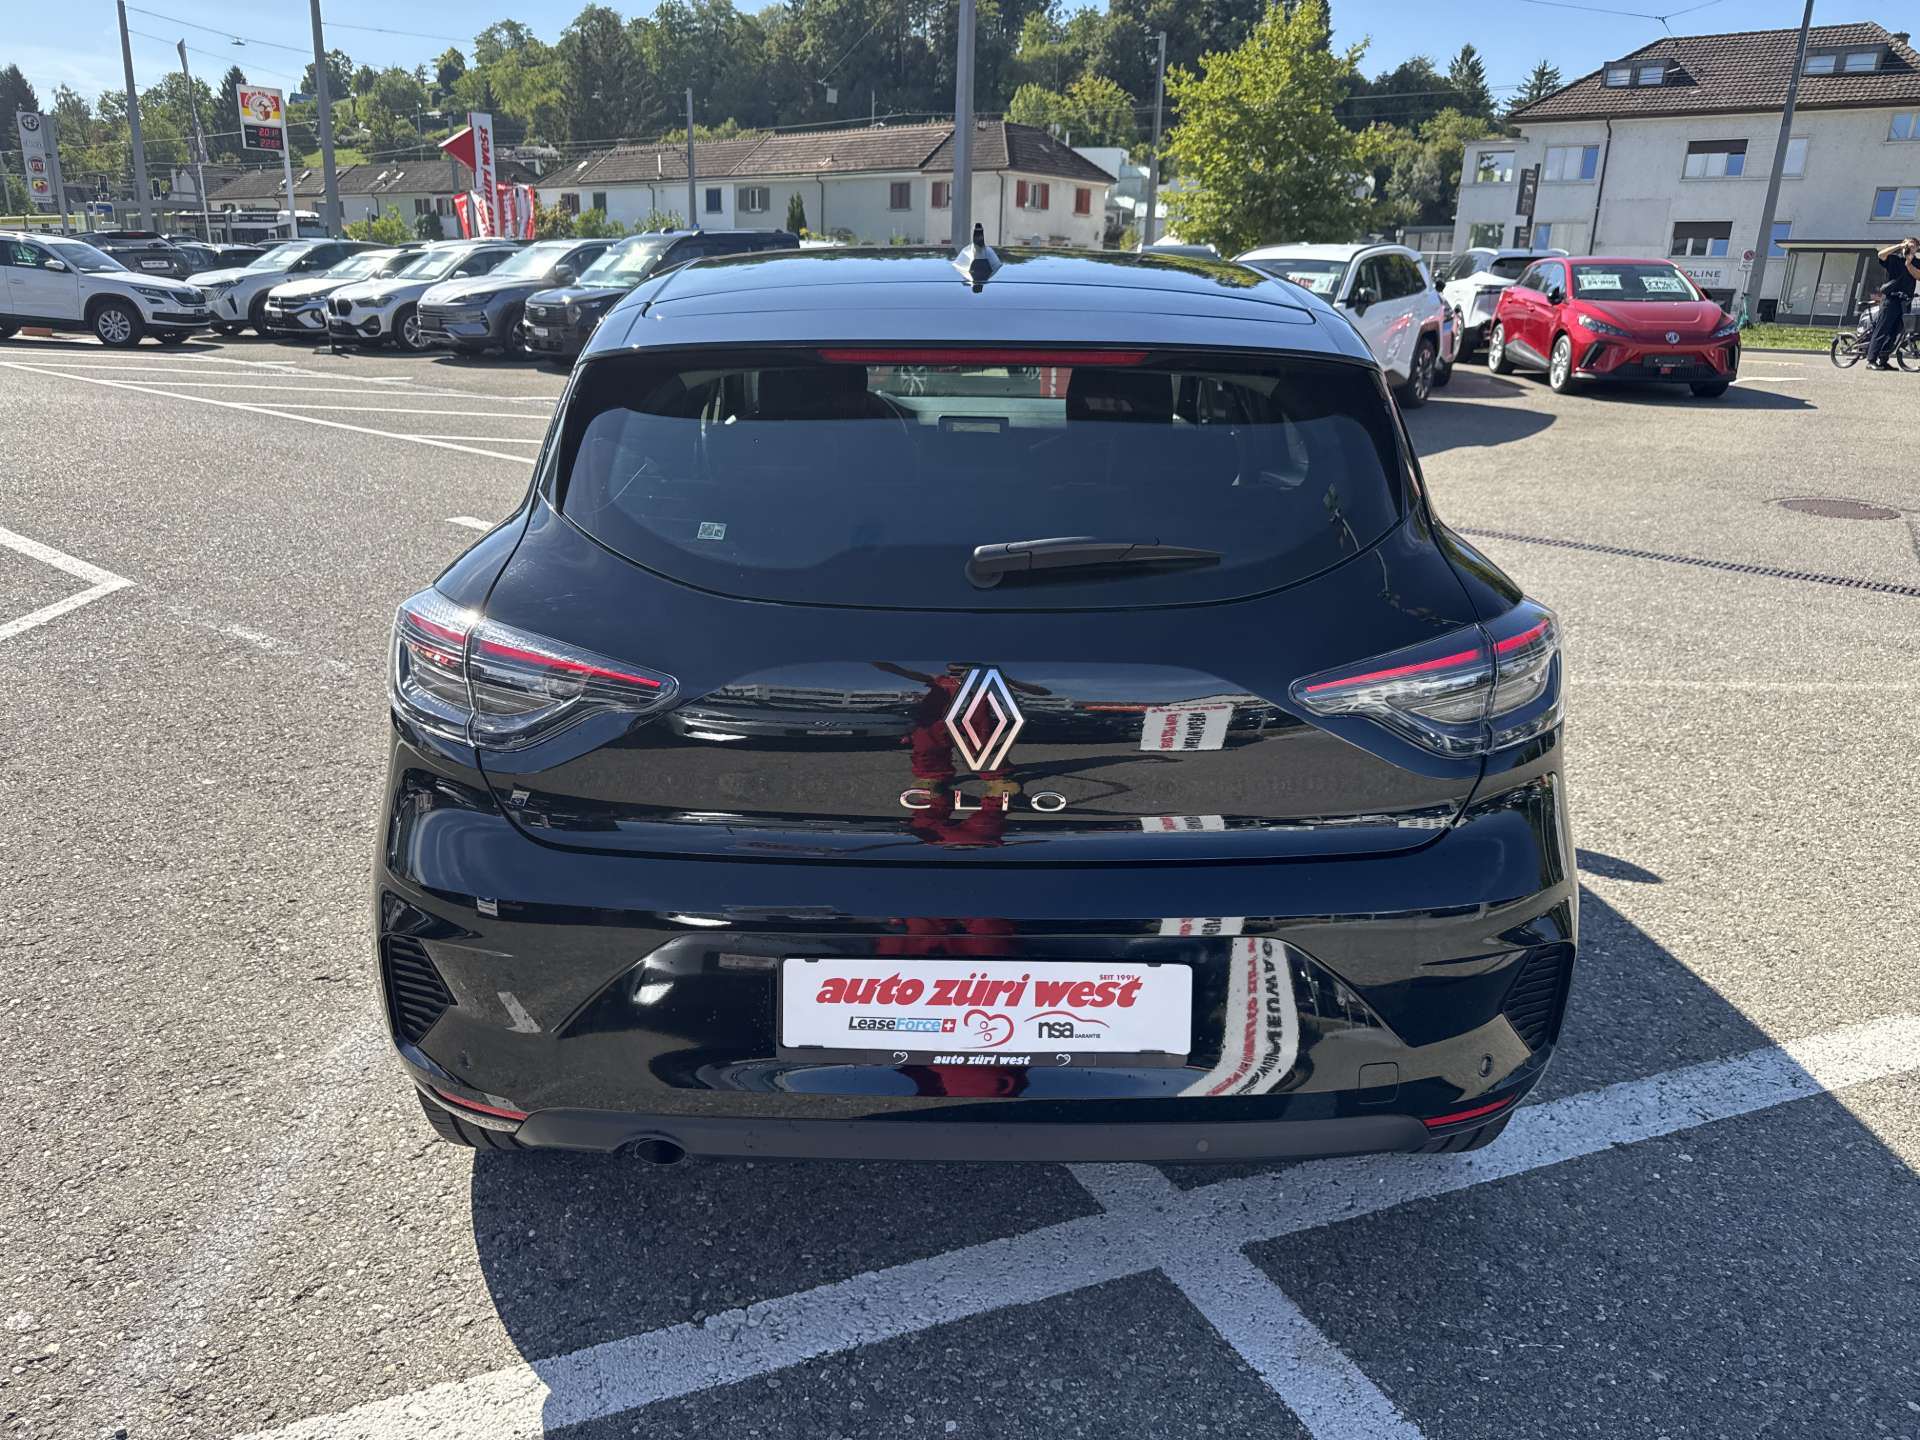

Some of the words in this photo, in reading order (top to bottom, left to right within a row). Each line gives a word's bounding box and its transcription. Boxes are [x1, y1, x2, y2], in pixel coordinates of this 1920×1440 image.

[899, 787, 1067, 812] CLIO
[816, 972, 924, 1006] auto
[925, 972, 1031, 1008] züri
[1034, 974, 1144, 1008] west
[848, 1016, 942, 1033] LeaseForce
[1038, 1021, 1074, 1039] nsa
[933, 1054, 965, 1065] auto
[966, 1054, 998, 1066] züri
[1000, 1054, 1031, 1066] west
